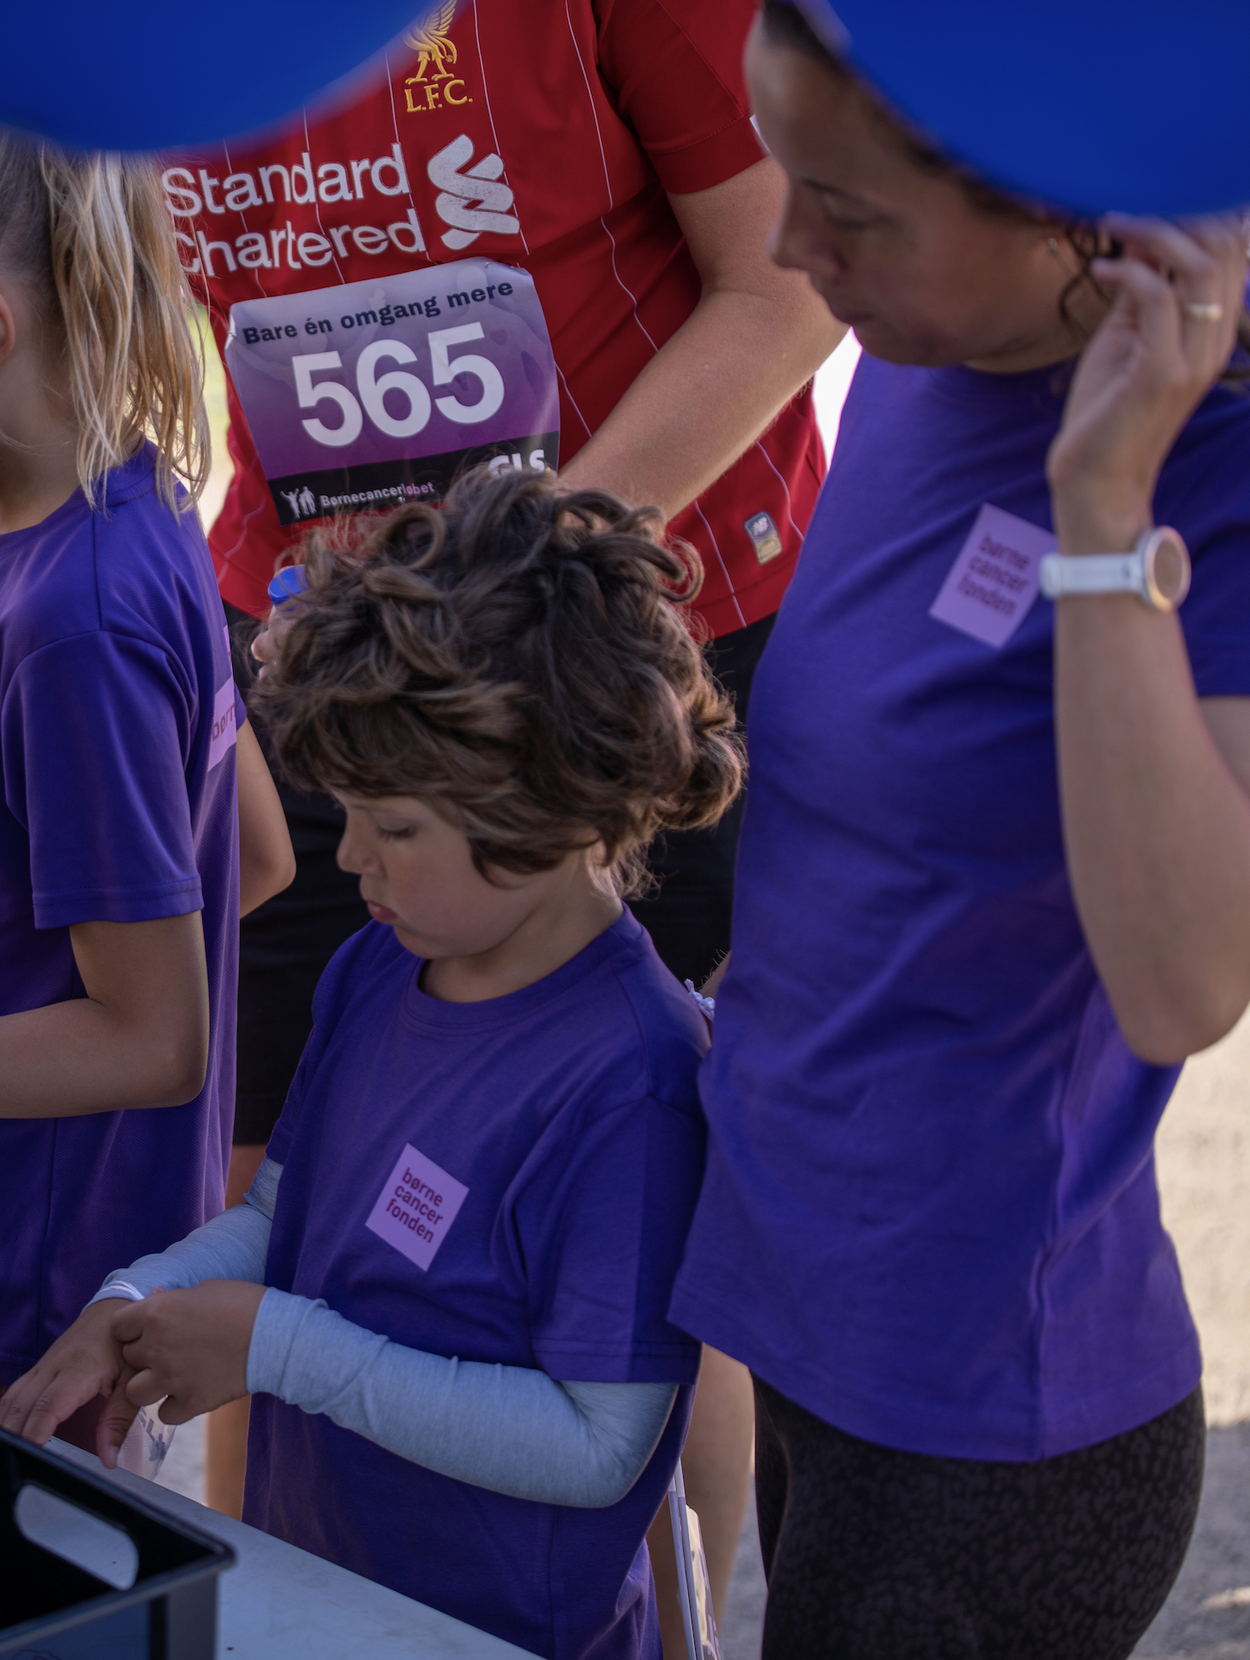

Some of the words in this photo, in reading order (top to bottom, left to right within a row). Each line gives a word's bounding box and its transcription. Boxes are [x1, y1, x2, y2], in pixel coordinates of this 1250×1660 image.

[403, 79, 474, 113] L.F.C.
[161, 142, 412, 218] Standard
[242, 324, 298, 345] Bare
[305, 317, 333, 336] én
[341, 296, 442, 327] omgang
[447, 281, 514, 309] mere
[291, 321, 506, 448] 565
[319, 481, 436, 510] Børnecancerløbet
[394, 1184, 444, 1226] cancer
[401, 1166, 444, 1207] børne
[386, 1198, 435, 1244] fonden
